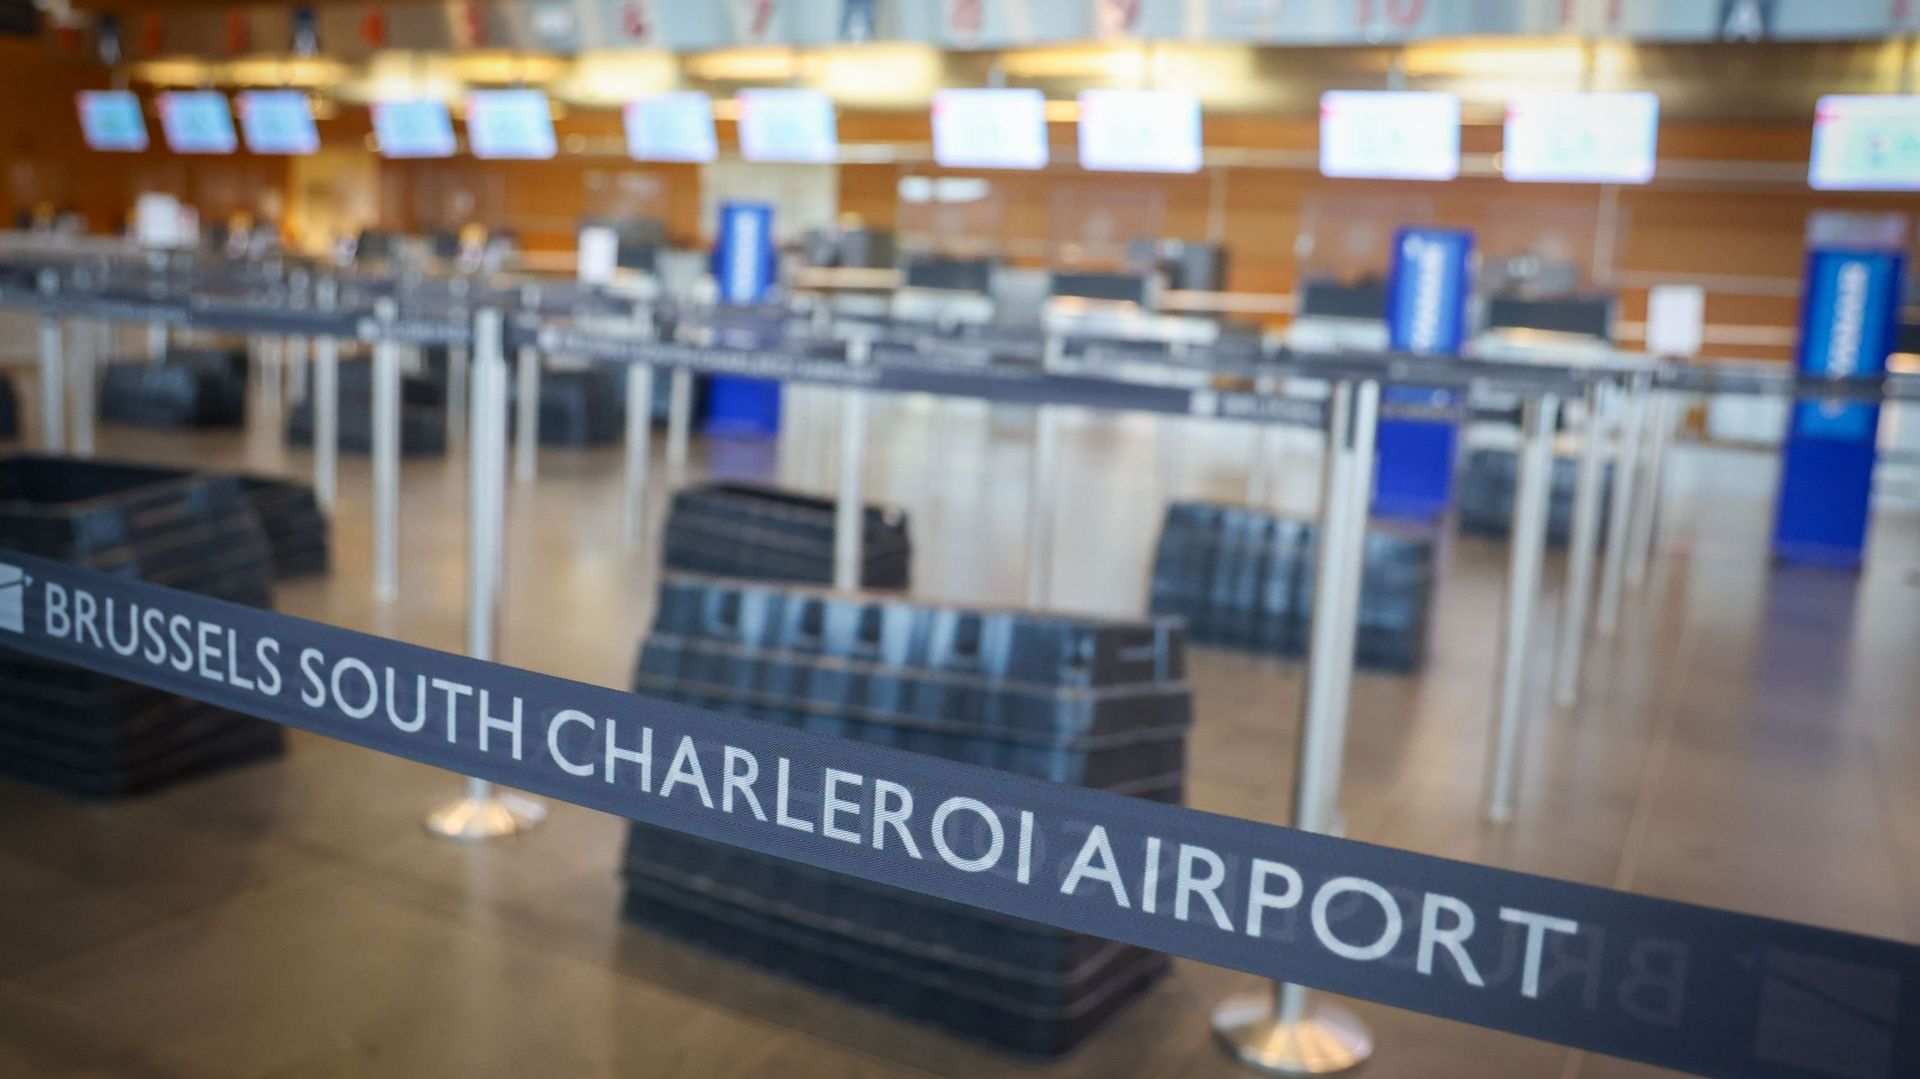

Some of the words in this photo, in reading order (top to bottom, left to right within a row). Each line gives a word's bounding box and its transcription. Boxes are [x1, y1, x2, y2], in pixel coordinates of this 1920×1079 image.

[45, 581, 282, 696] BRUSSELS
[300, 647, 523, 761] SOUTH
[547, 709, 1034, 885] CHARLEROI
[1060, 824, 1578, 999] AIRPORT
